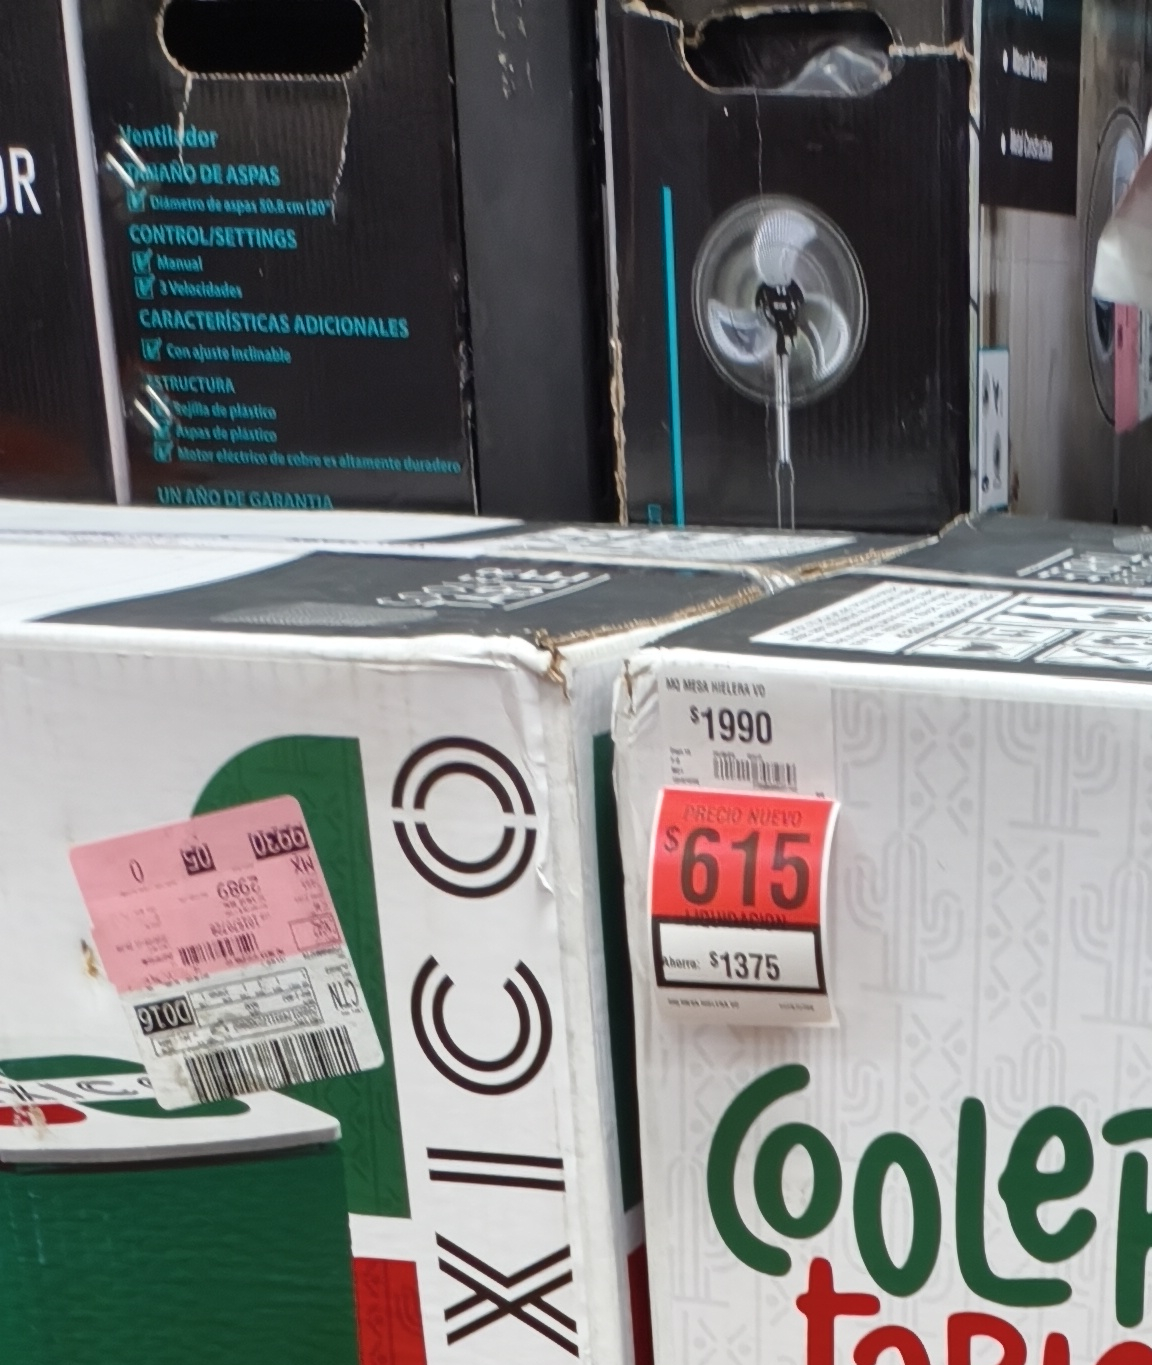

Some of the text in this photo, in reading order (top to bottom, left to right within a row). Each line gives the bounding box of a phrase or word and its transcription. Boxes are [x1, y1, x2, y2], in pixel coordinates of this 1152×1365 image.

[200, 164, 223, 185] DE
[226, 164, 281, 186] ASPAS
[129, 224, 297, 249] CONTROL/SETTINGS
[157, 253, 204, 272] Manual
[170, 280, 243, 298] Velocidades
[139, 308, 410, 339] CARACTERÍSTICAS ADICIONALES
[166, 343, 190, 359] Con
[231, 345, 292, 364] inclinable
[158, 485, 181, 504] UN
[186, 482, 220, 505] AÑO
[224, 489, 245, 507] DE
[682, 678, 709, 694] MESA
[690, 704, 773, 744] $1990
[682, 804, 803, 829] PRECIO NUEVO
[664, 825, 811, 910] $615
[709, 949, 781, 981] $1375
